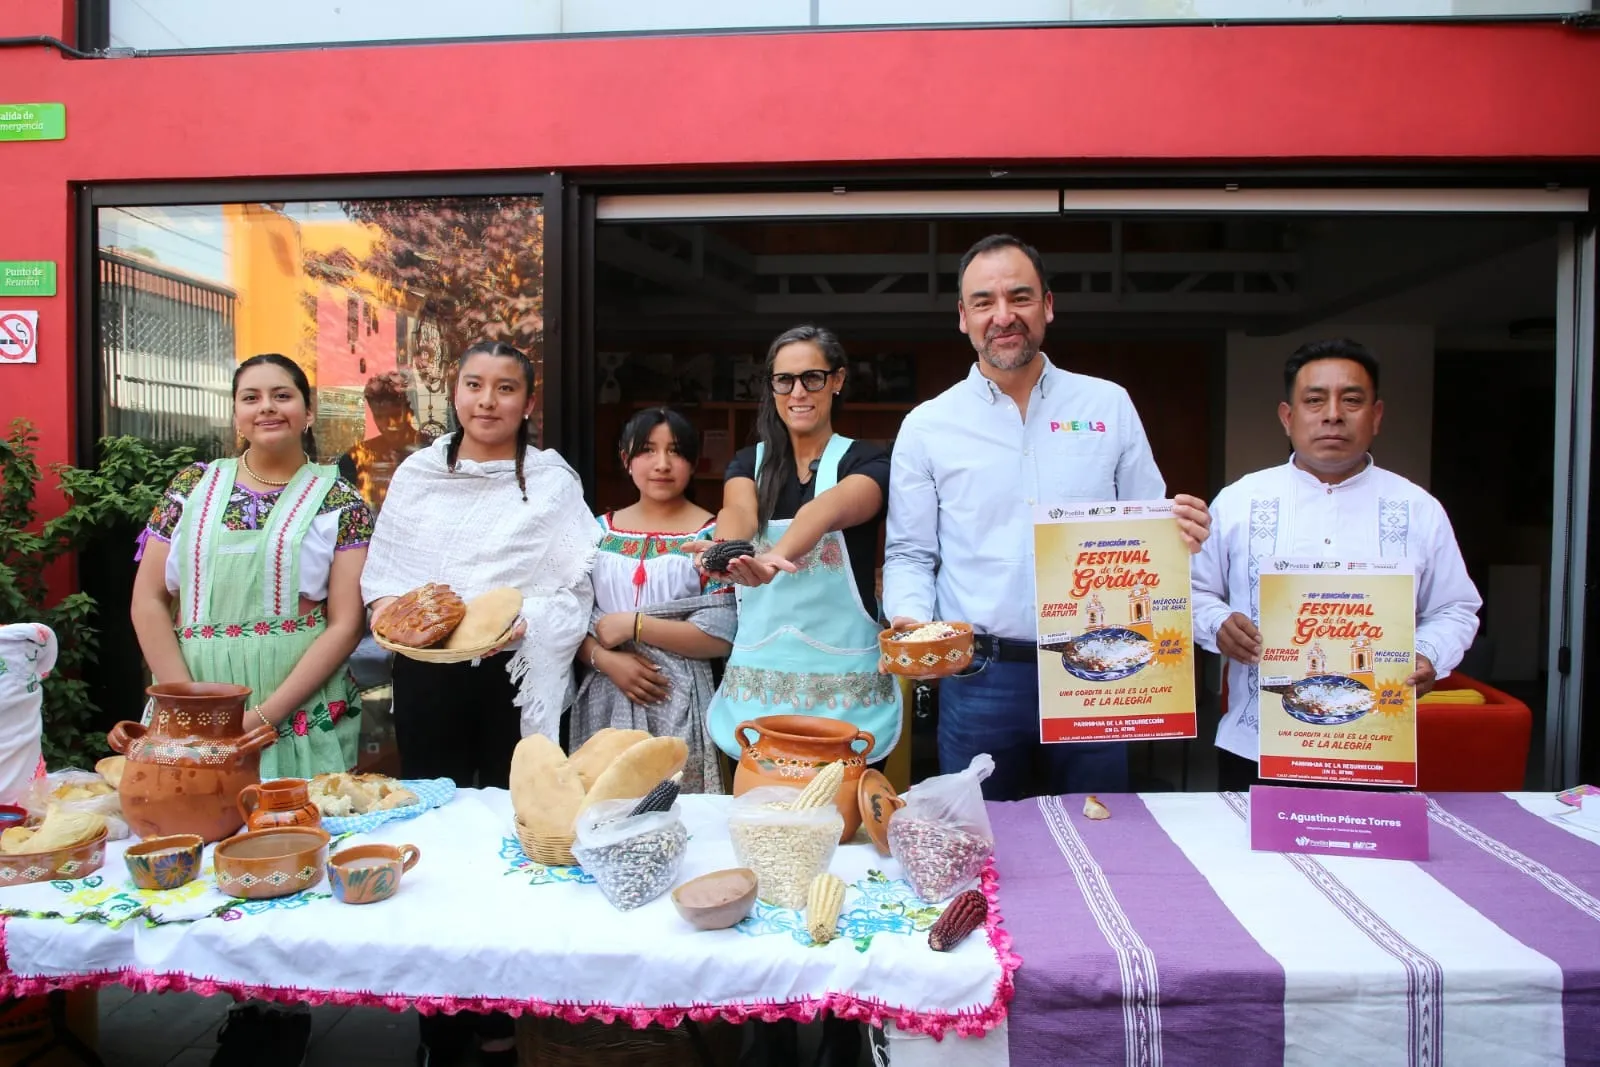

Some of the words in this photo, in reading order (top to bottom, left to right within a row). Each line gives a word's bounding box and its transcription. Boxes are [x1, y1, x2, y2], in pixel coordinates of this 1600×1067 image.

[0, 111, 22, 120] alida
[23, 110, 34, 120] de
[0, 120, 44, 133] mergencia
[5, 267, 31, 276] Punto
[32, 267, 43, 276] de
[1097, 539, 1126, 547] EDICIÓN
[1076, 550, 1151, 566] FESTIVAL
[1100, 566, 1110, 574] de
[1113, 566, 1124, 574] la
[1069, 567, 1160, 598] Gordita
[1042, 602, 1078, 610] ENTRADA
[1299, 602, 1374, 616] FESTIVAL
[1041, 610, 1077, 618] GRATUITA
[1323, 616, 1333, 624] de
[1292, 618, 1383, 645] Gordita
[1150, 685, 1173, 693] CLAVE
[1083, 698, 1096, 706] DE
[1099, 697, 1111, 705] LA
[1113, 694, 1153, 705] ALEGRÍA
[1370, 734, 1393, 742] CLAVE
[1301, 740, 1314, 748] DE
[1317, 740, 1330, 748] LA
[1331, 739, 1372, 750] ALEGRÍA
[1278, 811, 1289, 821] C.
[1290, 812, 1337, 824] Agustina
[1338, 815, 1367, 825] Pérez
[1367, 817, 1402, 827] Torres
